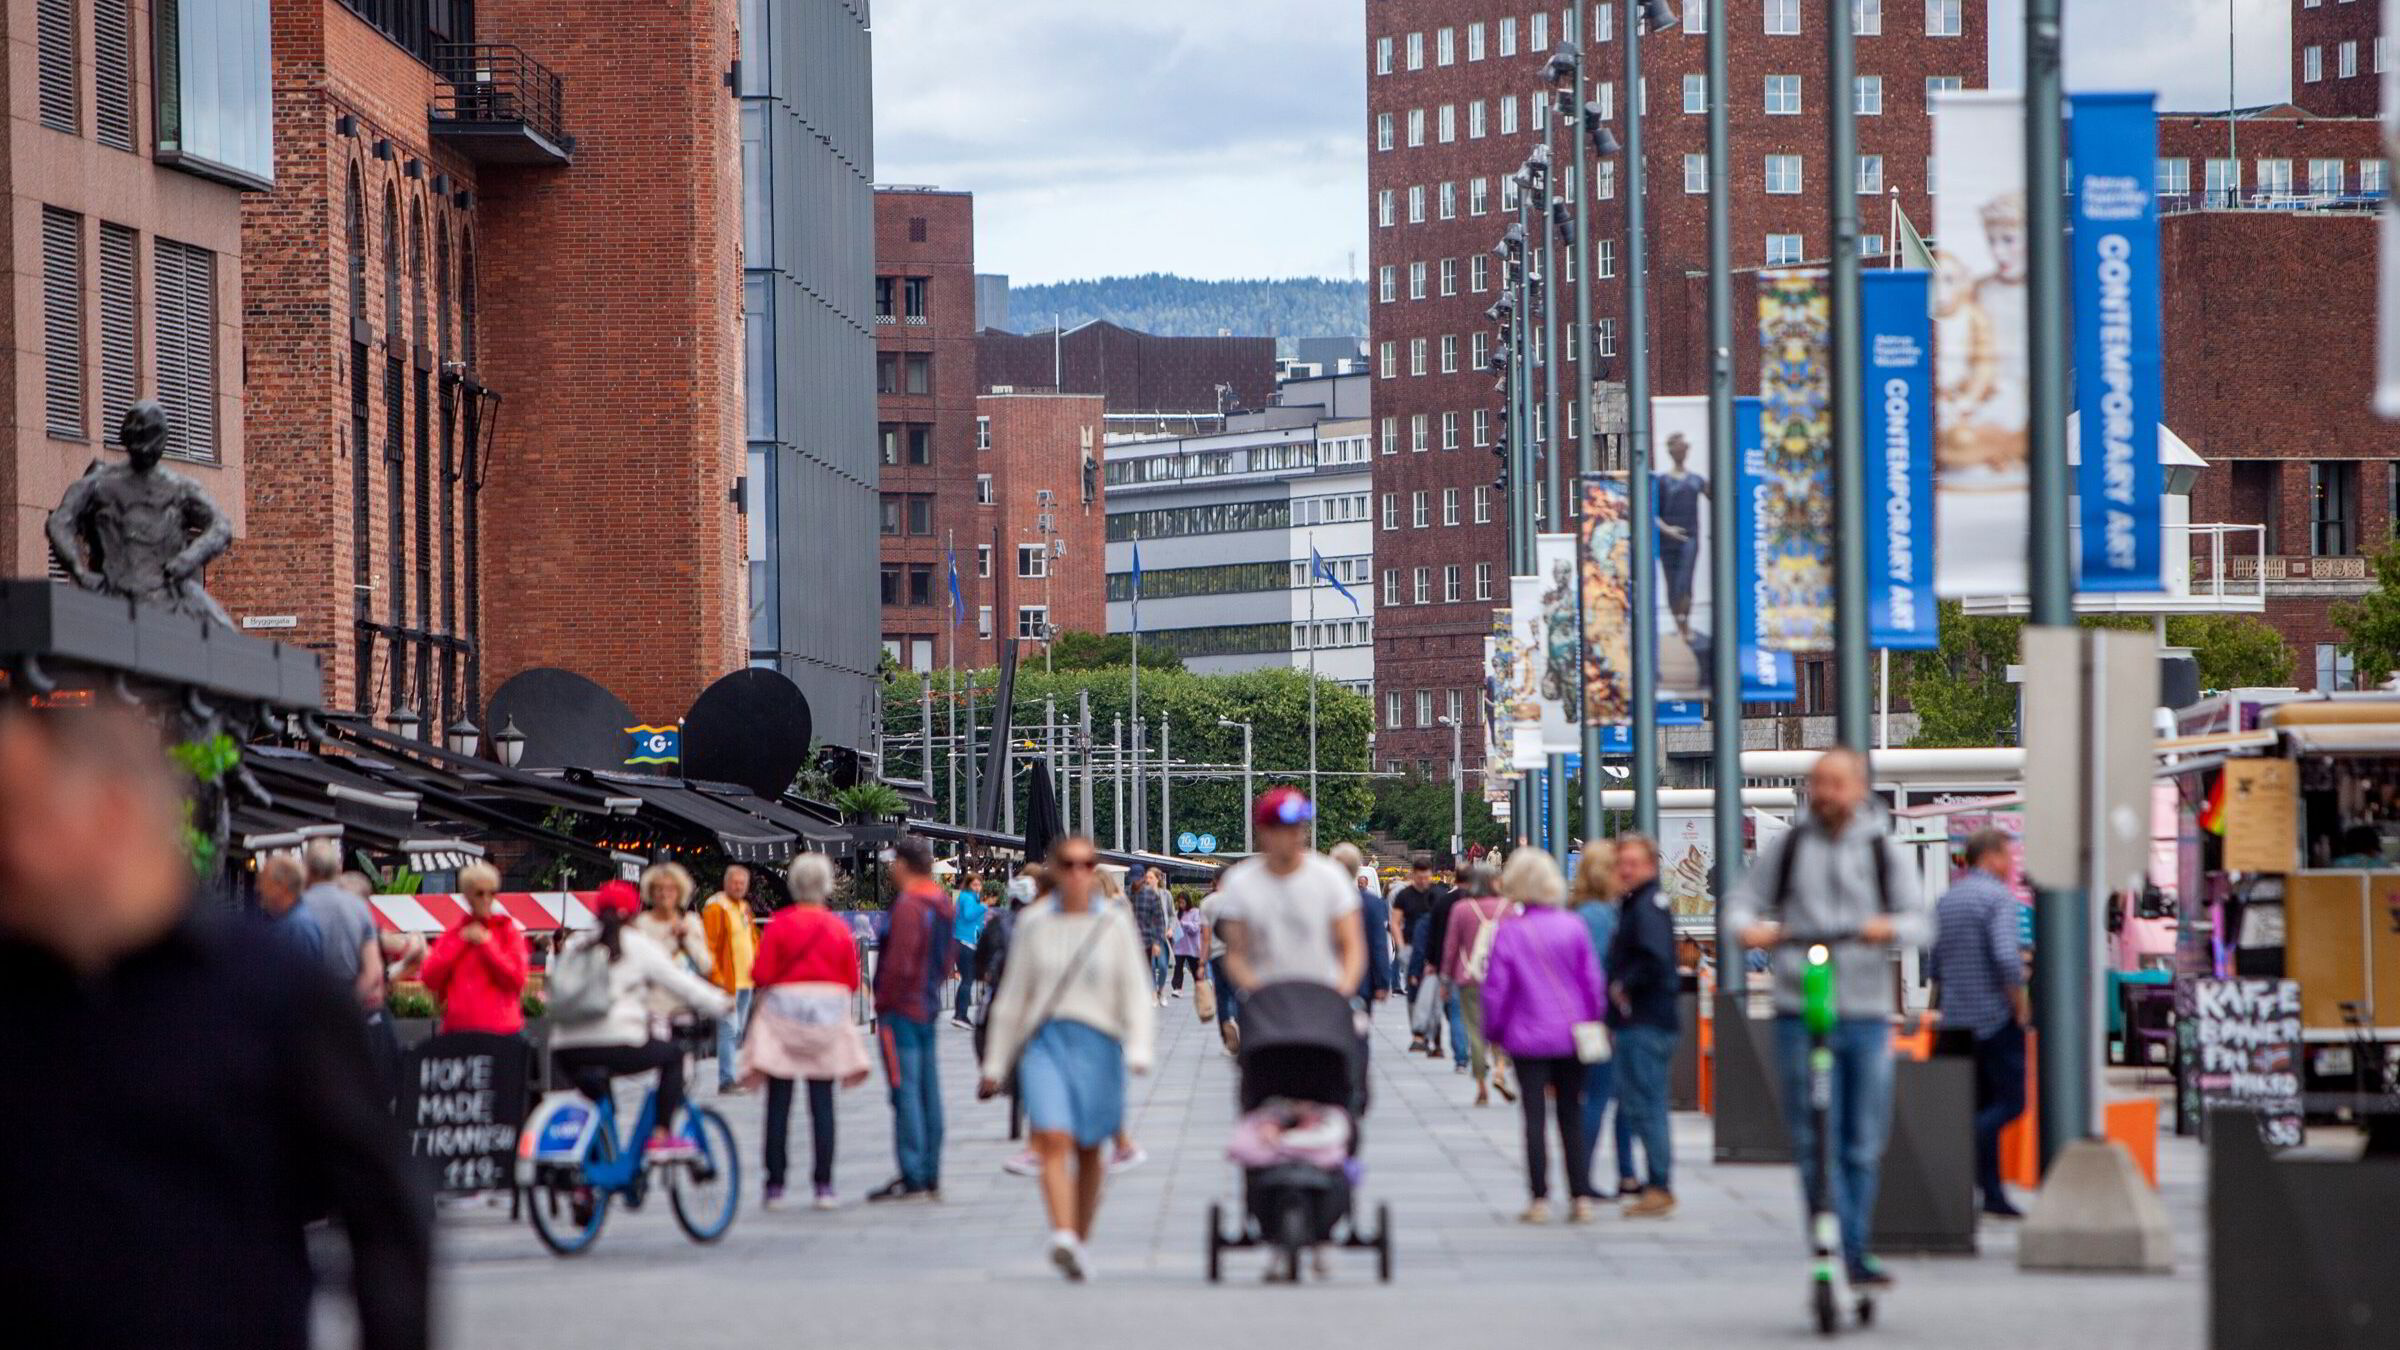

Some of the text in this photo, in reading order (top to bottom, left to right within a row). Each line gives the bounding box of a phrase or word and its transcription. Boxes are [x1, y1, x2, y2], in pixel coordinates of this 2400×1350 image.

[2097, 234, 2134, 504] CONTEMPORARY
[1885, 378, 1913, 583] CONTEMPORARY
[2104, 509, 2136, 571] ART
[1888, 584, 1915, 632] ART
[1756, 650, 1778, 686] ART
[2195, 979, 2301, 1019] KAFFE
[420, 1055, 494, 1091] HOME
[417, 1090, 496, 1126] MADE
